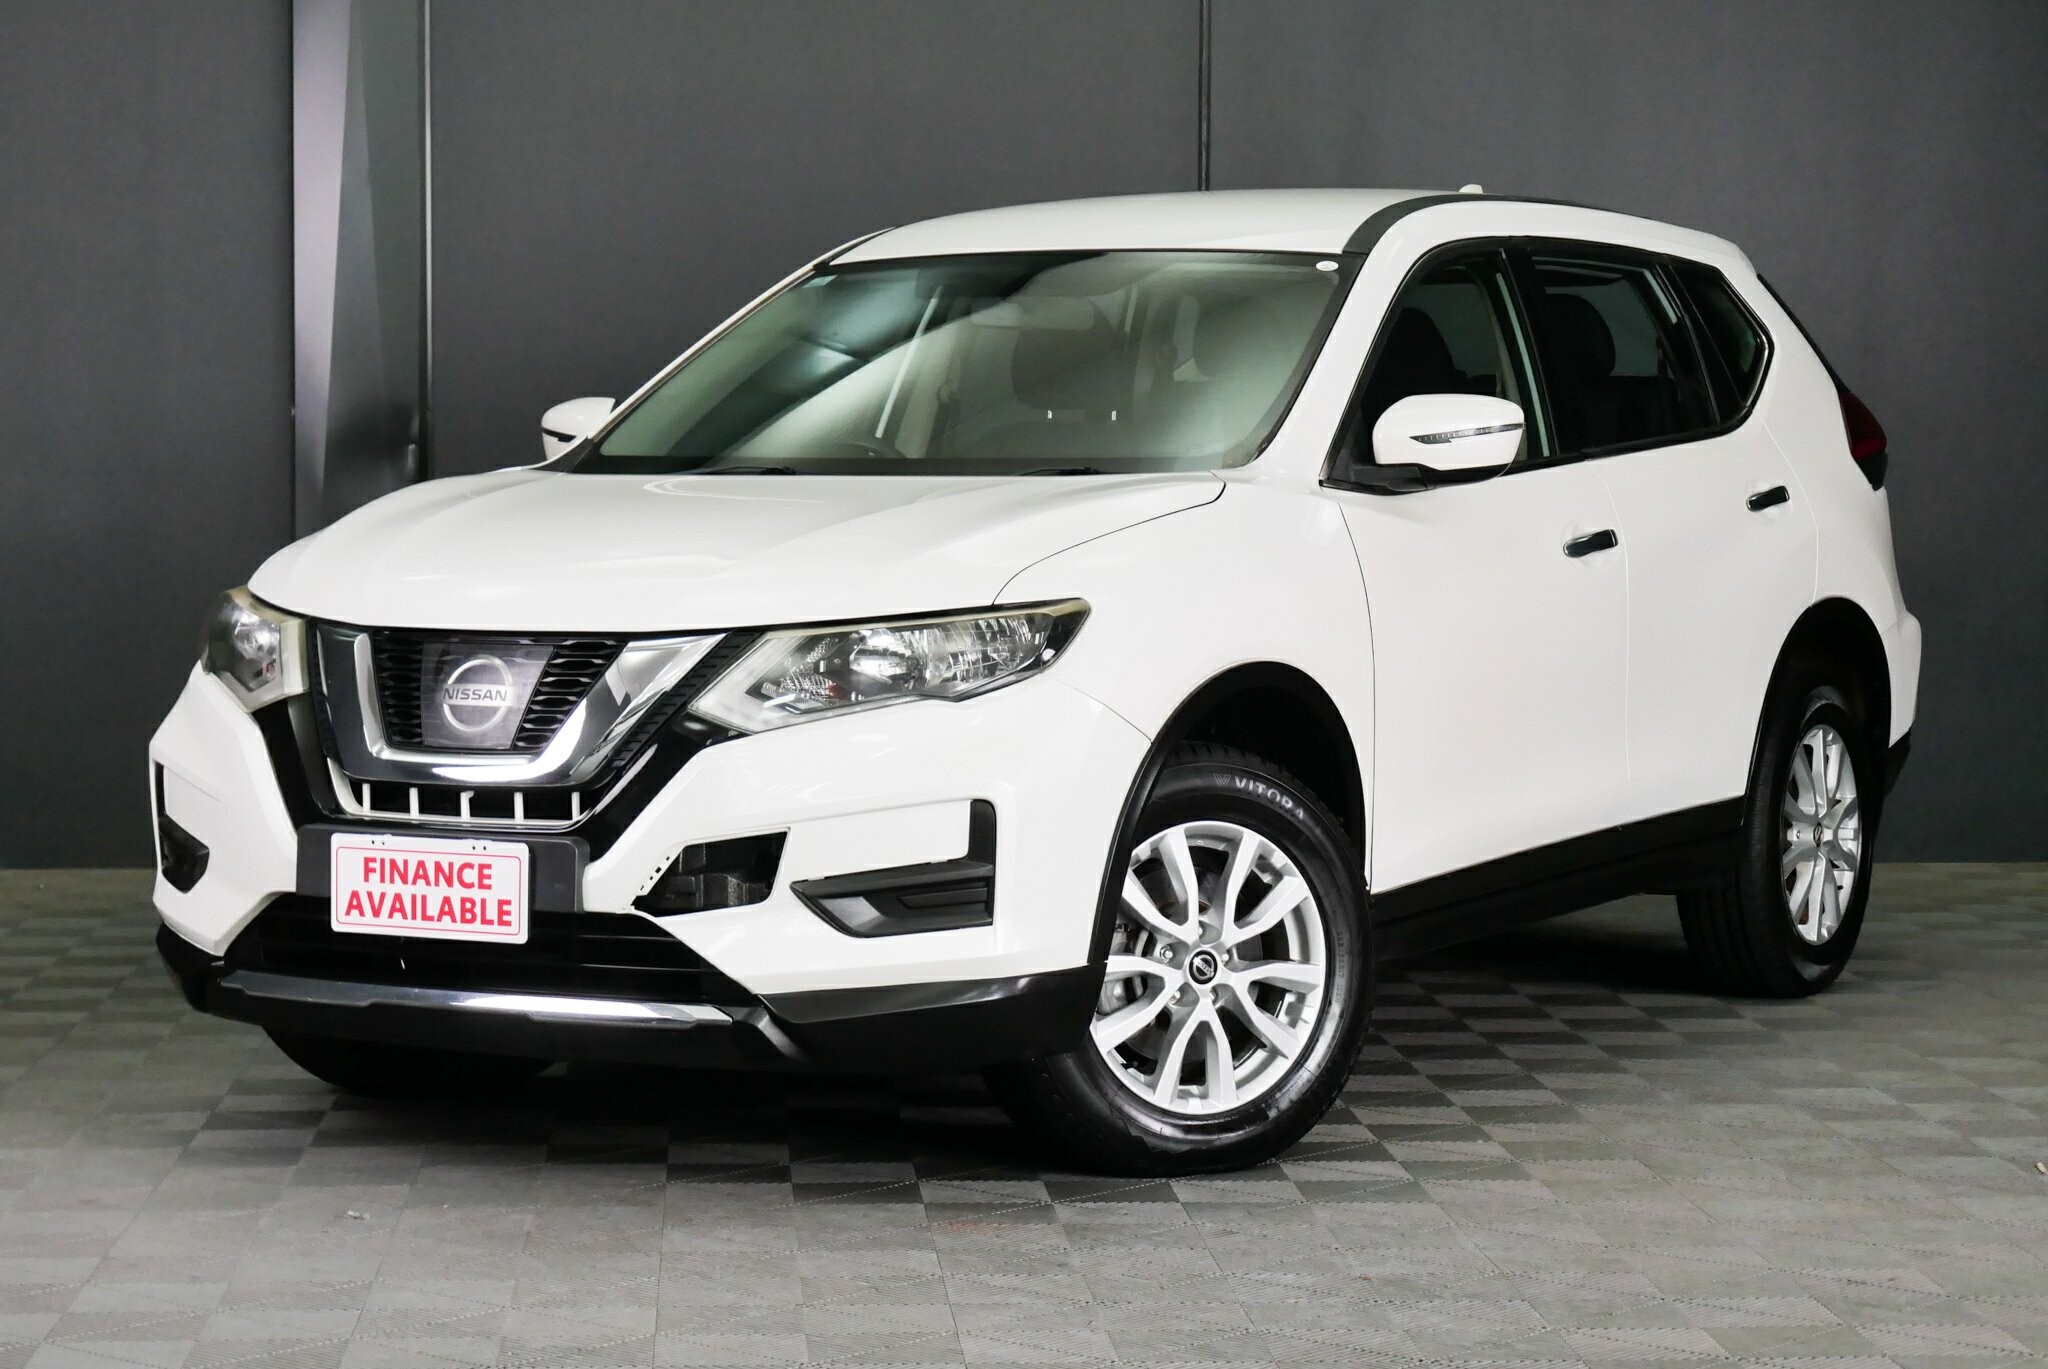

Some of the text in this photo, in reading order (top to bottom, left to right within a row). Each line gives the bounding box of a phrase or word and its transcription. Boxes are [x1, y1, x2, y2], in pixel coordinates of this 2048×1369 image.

[443, 687, 508, 701] NISSAN
[1234, 775, 1304, 820] VITORA
[363, 857, 493, 890] FINANCE
[344, 890, 512, 927] AVAILABLE
